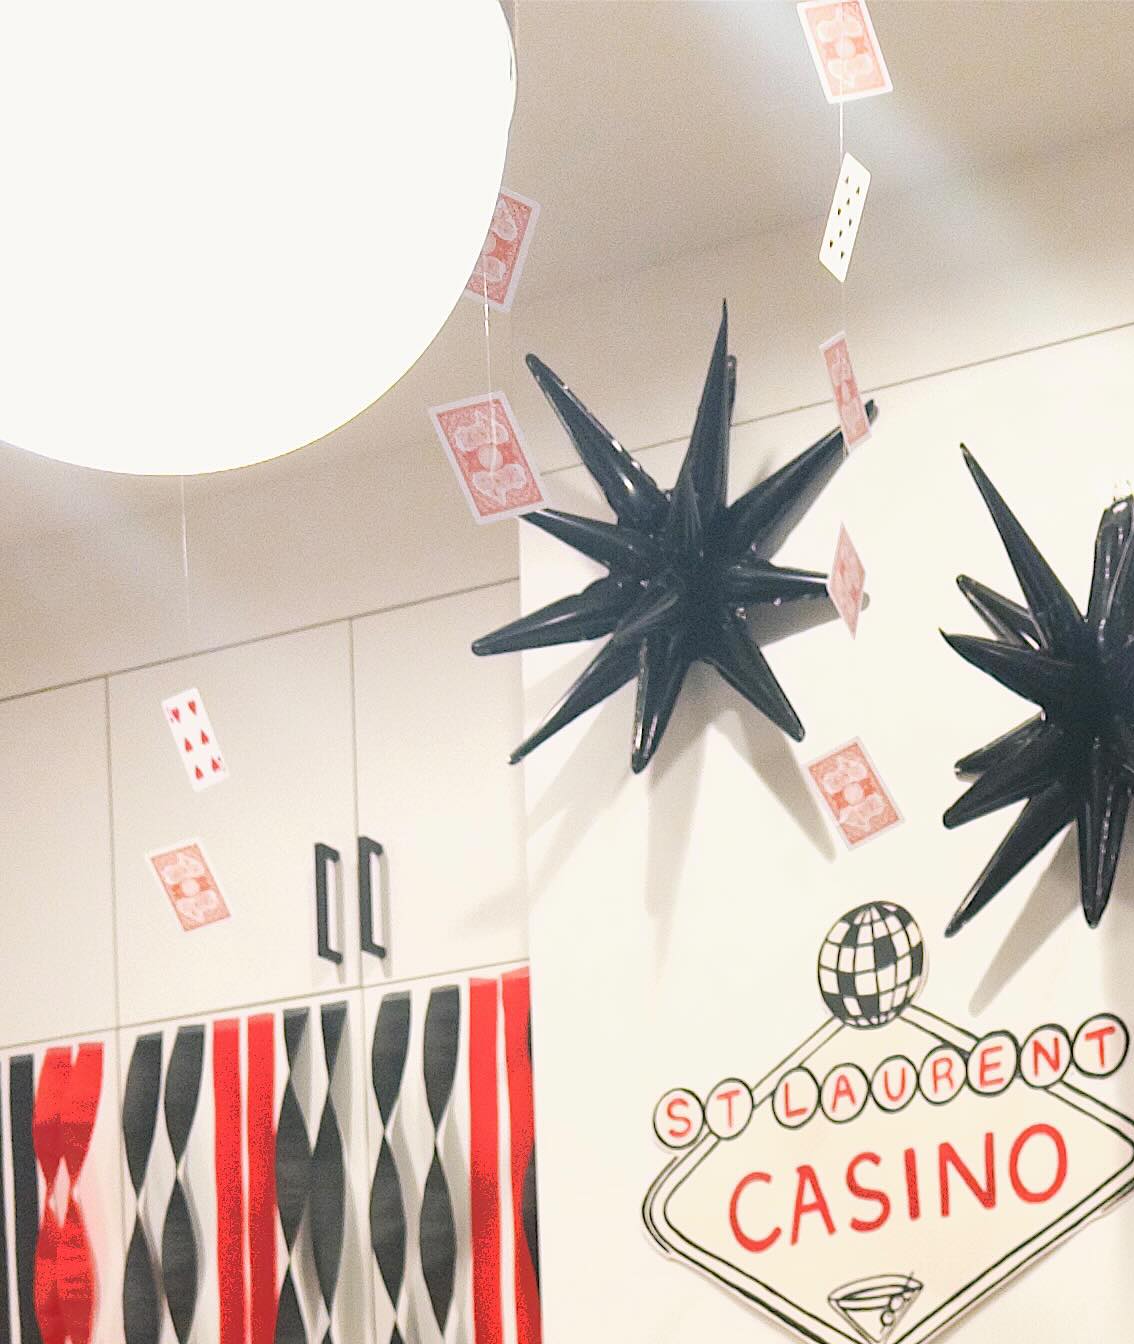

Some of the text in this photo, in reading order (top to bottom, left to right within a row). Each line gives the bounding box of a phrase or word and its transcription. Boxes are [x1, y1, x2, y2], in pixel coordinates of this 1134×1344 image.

[667, 1026, 1116, 1138] ST LAURENT
[729, 1123, 1068, 1252] CASINO
